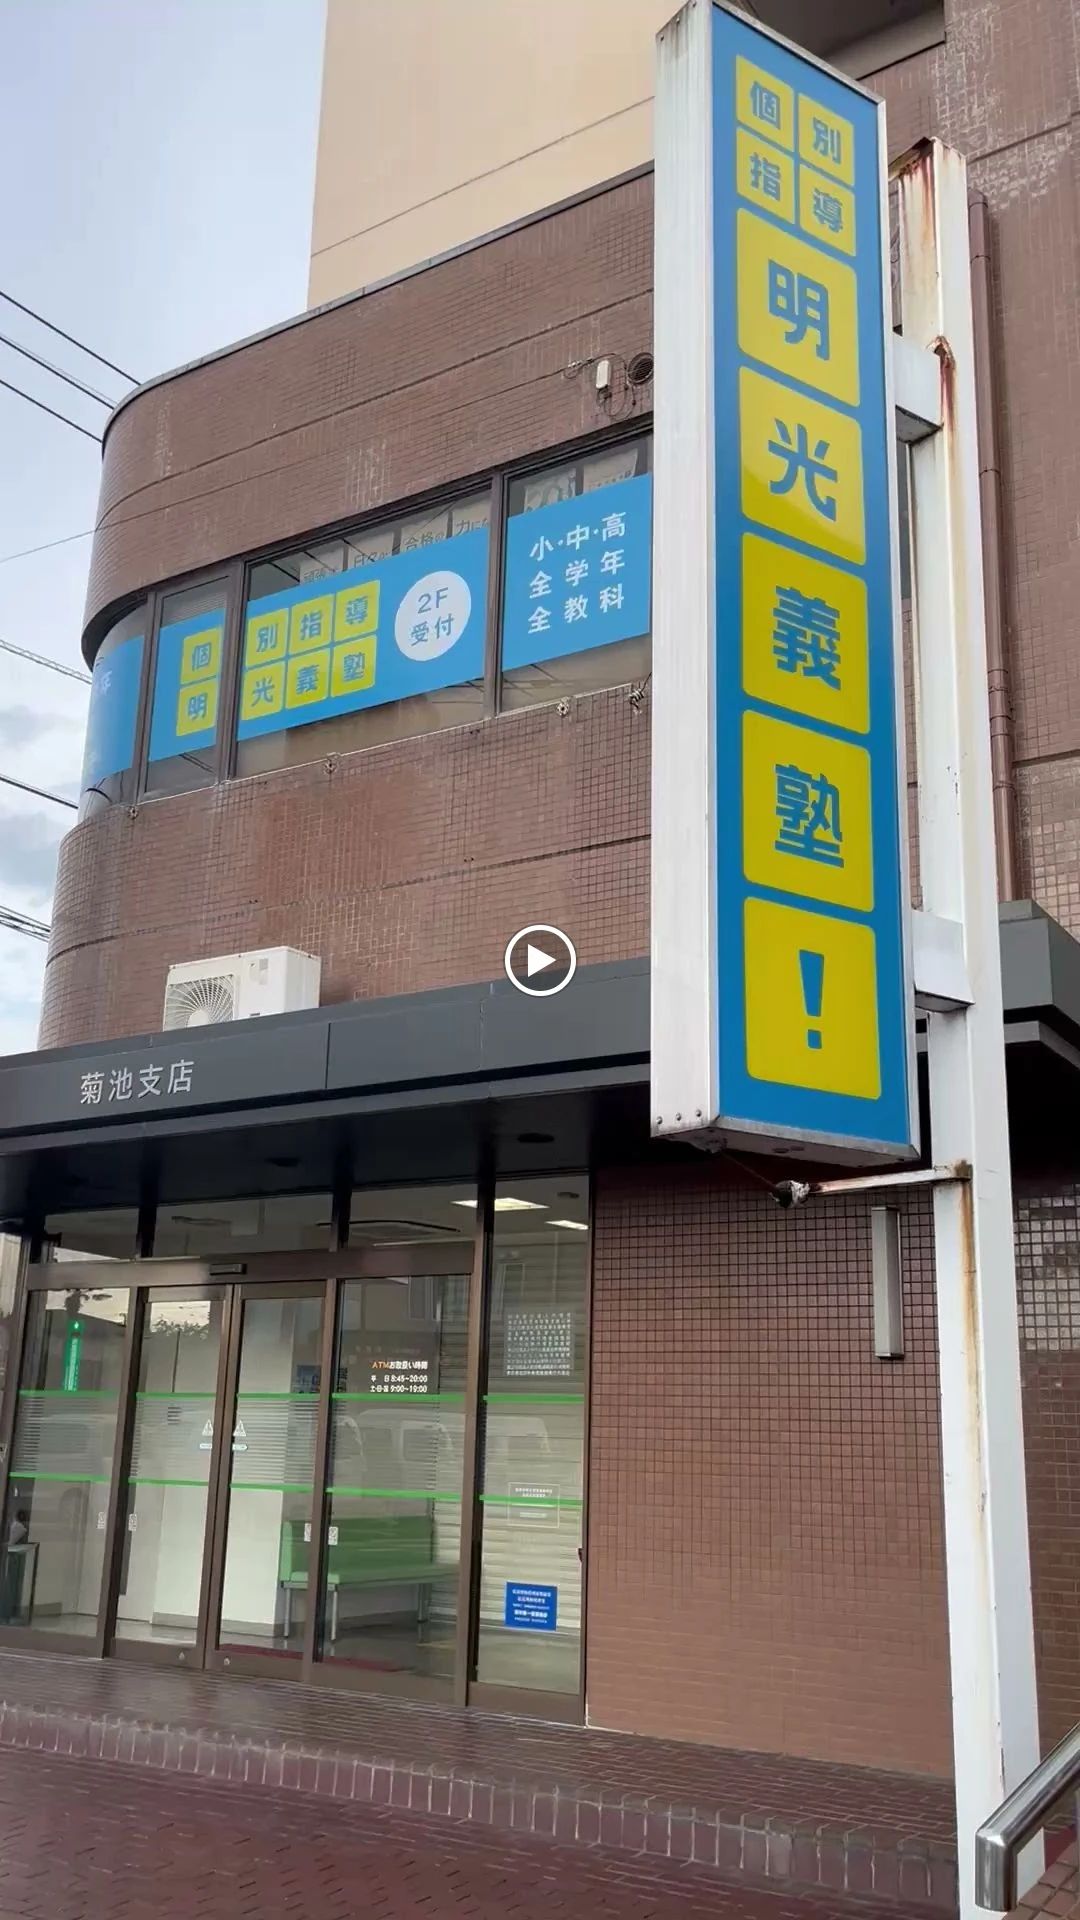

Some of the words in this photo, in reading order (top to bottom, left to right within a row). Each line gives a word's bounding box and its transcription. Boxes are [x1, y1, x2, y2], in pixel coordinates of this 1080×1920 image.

[750, 80, 842, 164] 個別
[749, 152, 844, 234] 指導
[529, 549, 625, 599] 全学年
[417, 587, 449, 614] 2F
[528, 583, 625, 634] 全教科
[410, 613, 454, 647] 受付
[80, 1059, 195, 1105] 菊池支店
